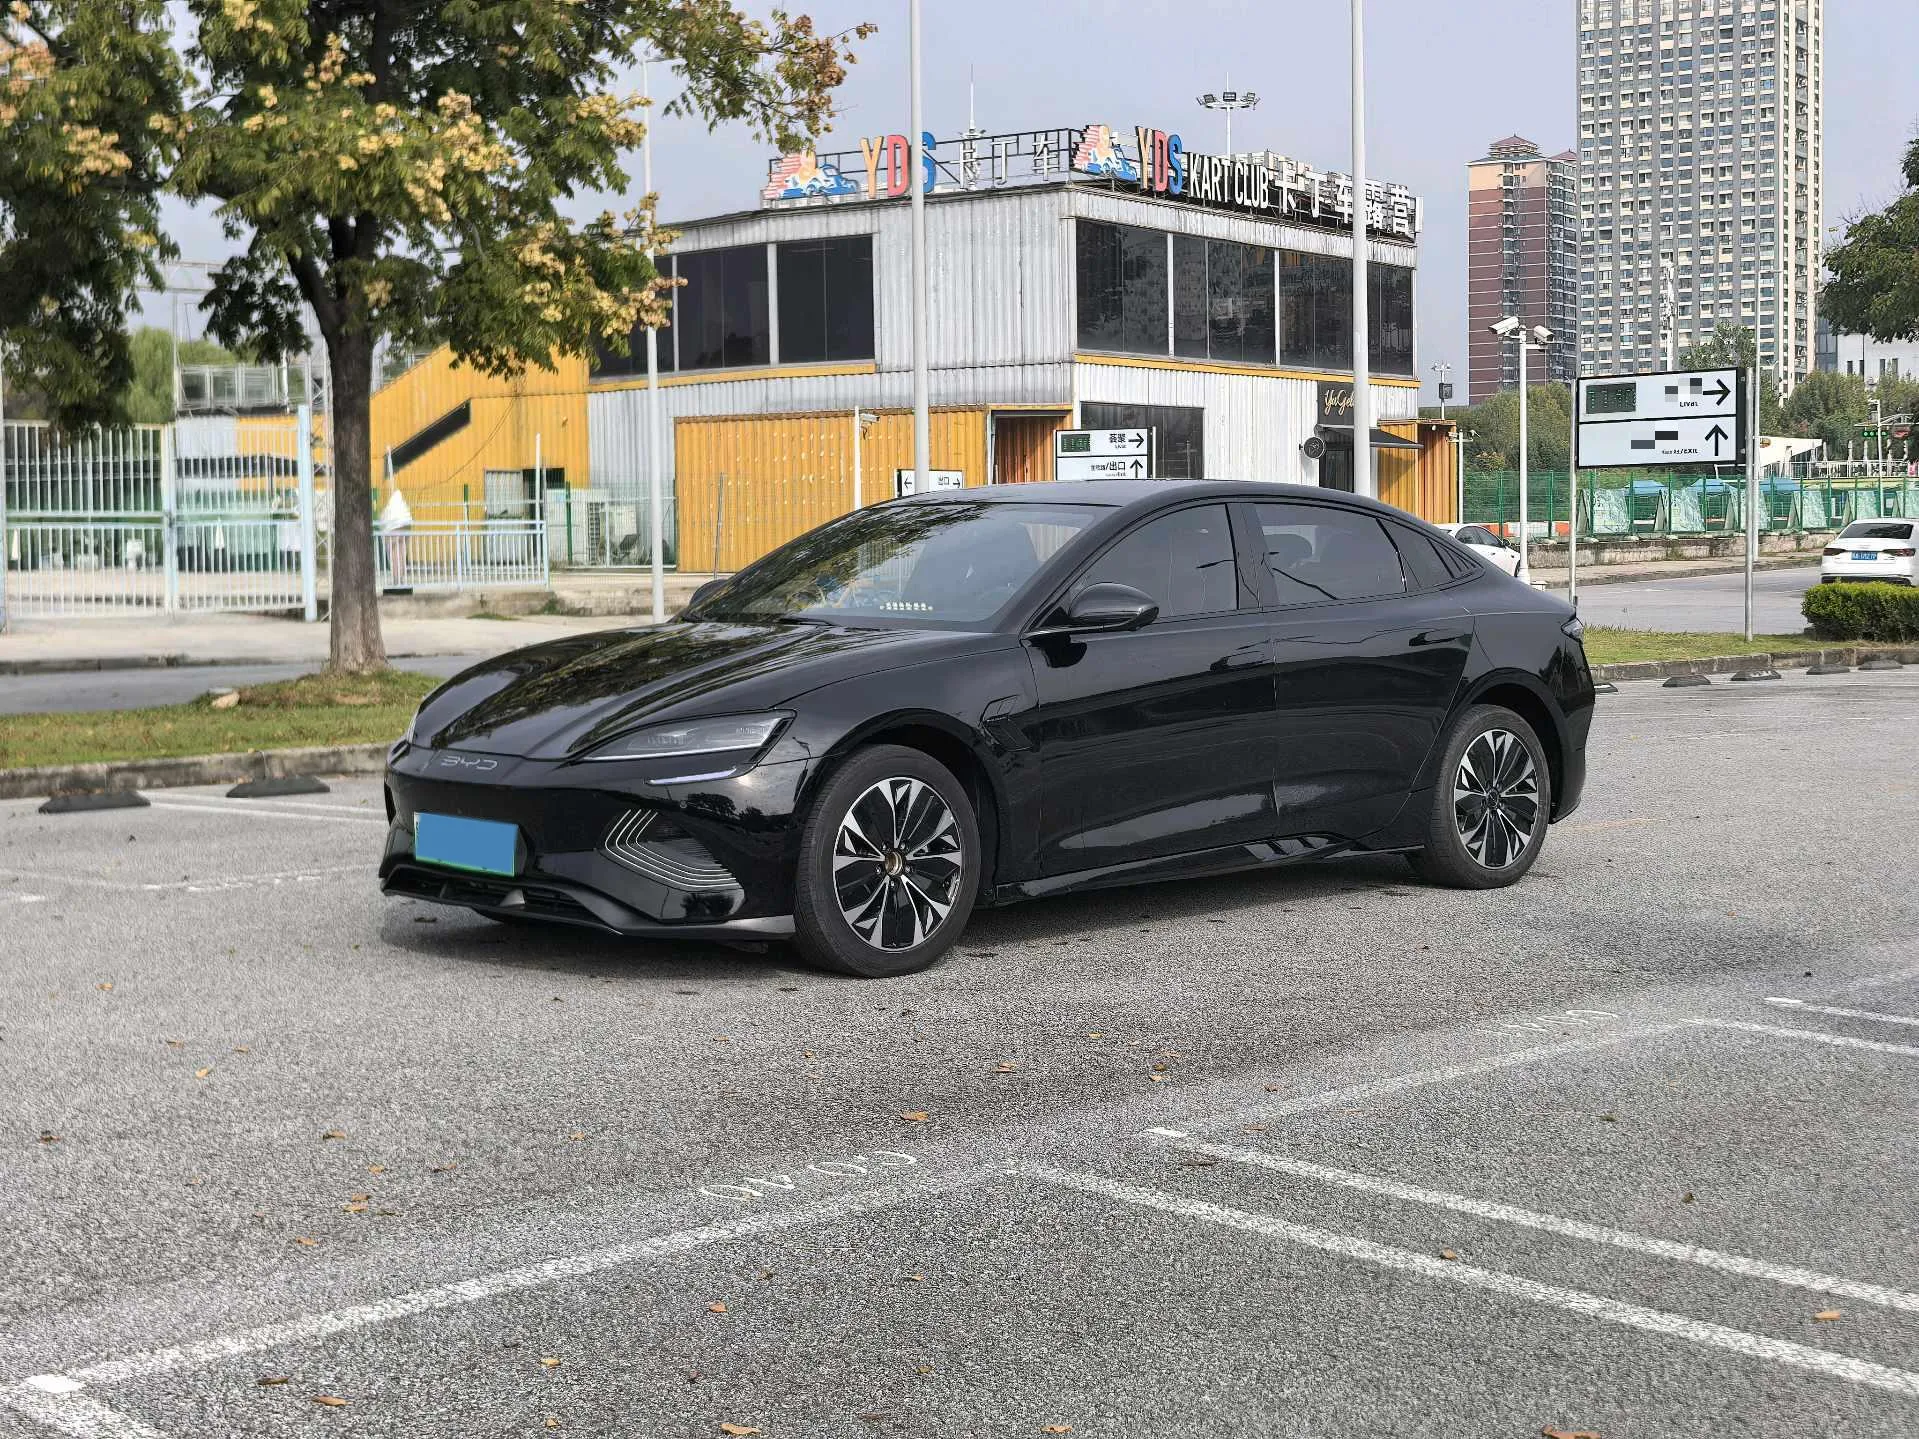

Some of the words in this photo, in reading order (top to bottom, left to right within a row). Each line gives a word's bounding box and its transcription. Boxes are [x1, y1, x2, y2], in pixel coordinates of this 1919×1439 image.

[860, 131, 937, 199] YDS
[950, 133, 1060, 190] 卡丁车
[1134, 126, 1183, 195] YDS
[1189, 152, 1232, 203] KART
[1234, 161, 1269, 209] CLUB
[440, 755, 498, 771] BYD
